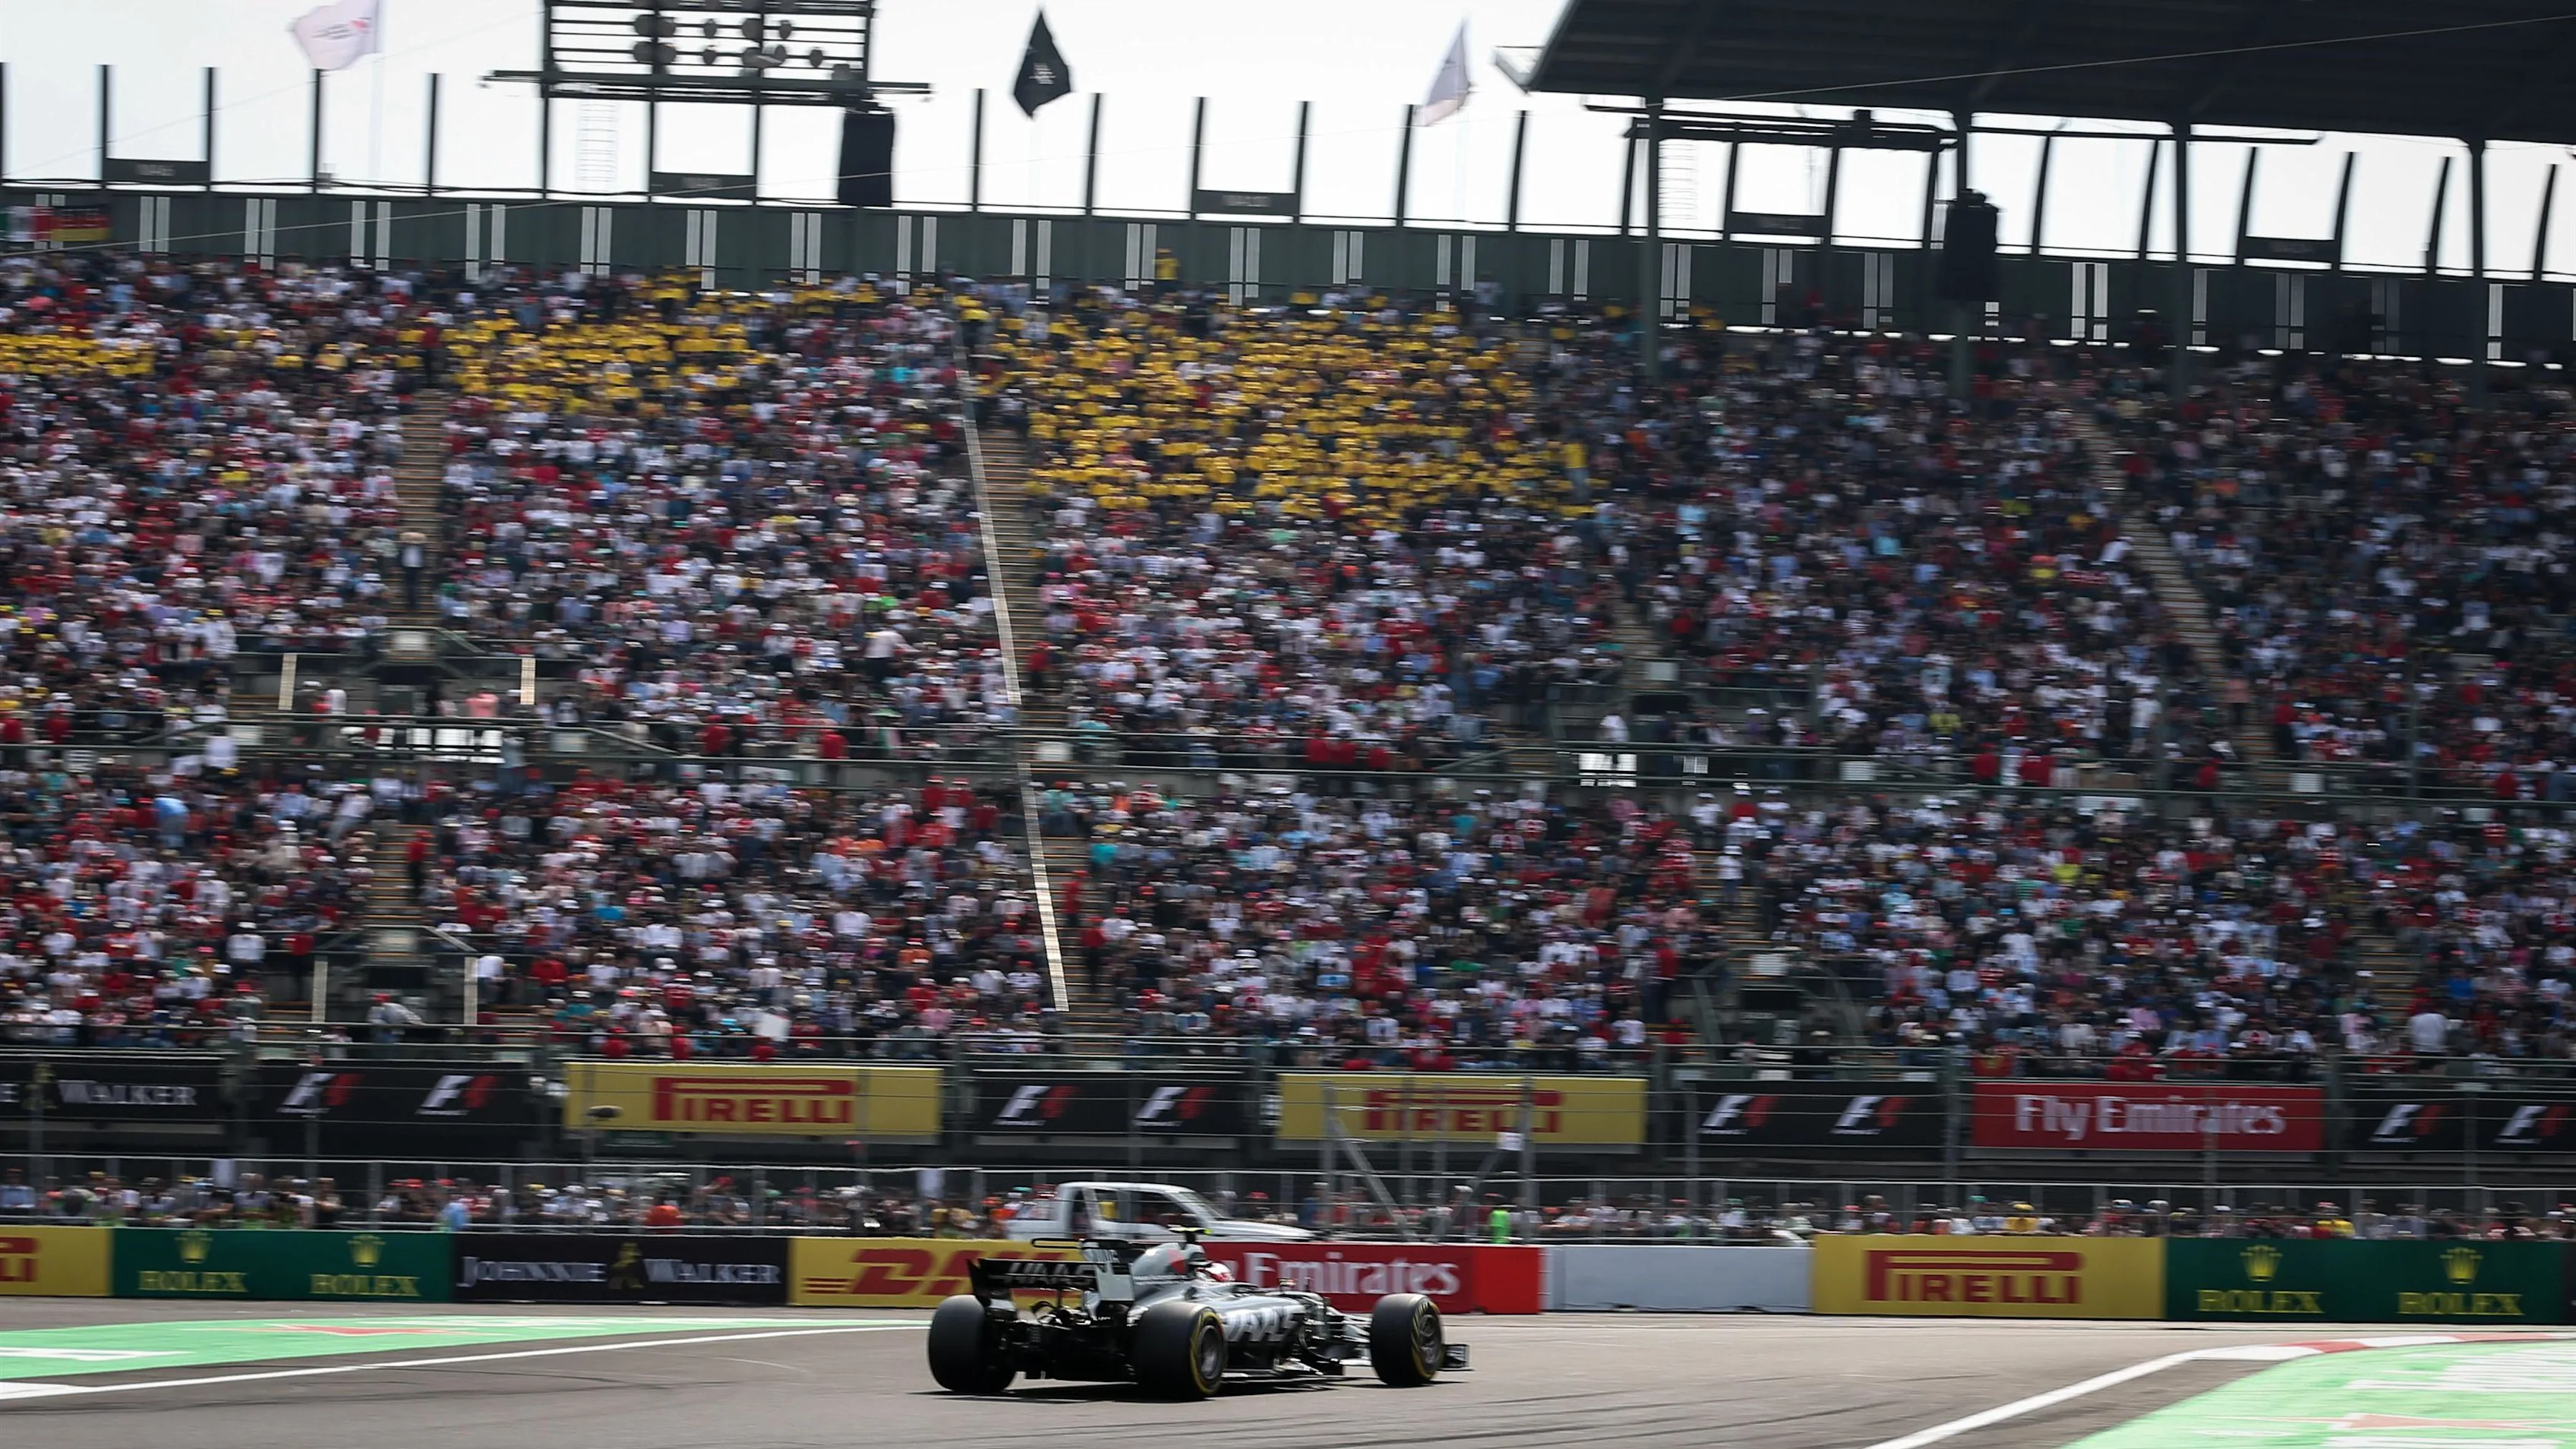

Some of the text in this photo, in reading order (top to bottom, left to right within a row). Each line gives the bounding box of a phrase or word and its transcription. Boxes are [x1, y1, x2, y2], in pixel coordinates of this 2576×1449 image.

[653, 1077, 855, 1123] PIRELLI
[2016, 1094, 2286, 1140] Fly Emirates
[139, 1271, 248, 1293] ROLEX
[311, 1274, 421, 1296] ROLEX
[1243, 1251, 1460, 1296] Emirates
[1864, 1250, 2085, 1305] PIRELLI
[2197, 1290, 2324, 1314] ROLEX
[2398, 1293, 2525, 1316] ROLEX
